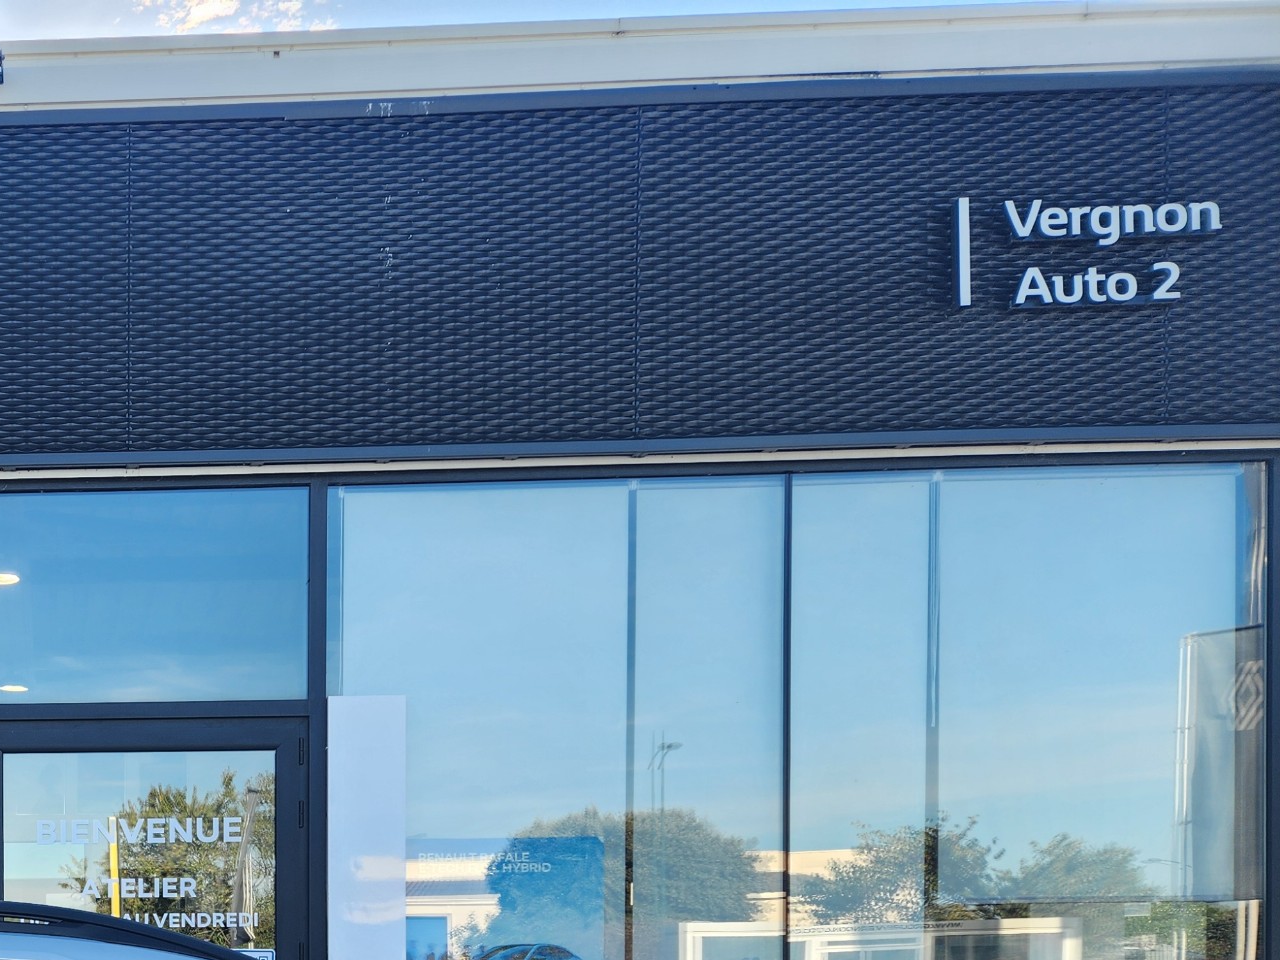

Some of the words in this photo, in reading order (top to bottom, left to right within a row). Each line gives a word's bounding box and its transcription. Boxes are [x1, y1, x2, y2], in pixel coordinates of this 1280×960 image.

[1004, 199, 1223, 246] Vergnon
[1015, 266, 1138, 304] Auto
[1151, 261, 1182, 300] 2
[36, 816, 242, 845] BIENVENUE
[502, 862, 552, 873] HYBRID
[80, 877, 197, 899] ATELIER
[153, 912, 259, 929] VENDREDI
